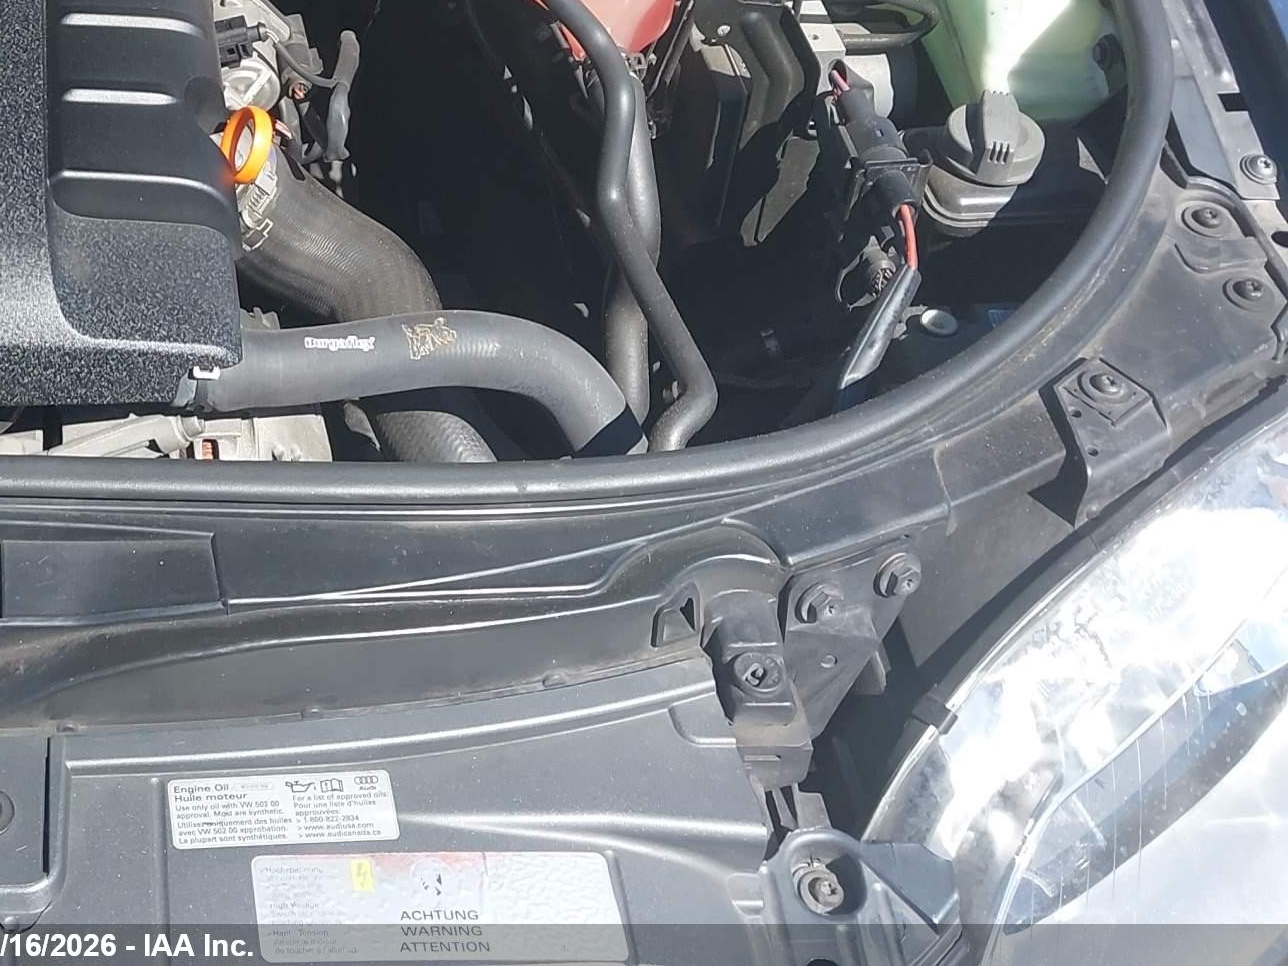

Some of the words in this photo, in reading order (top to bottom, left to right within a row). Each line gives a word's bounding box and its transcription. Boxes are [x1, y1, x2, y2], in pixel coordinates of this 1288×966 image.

[173, 785, 211, 795] Engine
[214, 784, 229, 792] Oil
[174, 794, 202, 802] Huile
[206, 793, 248, 801] moteur
[192, 804, 208, 812] only
[222, 802, 238, 810] with
[198, 828, 211, 836] VW
[400, 909, 480, 921] ACHTUNG
[400, 925, 483, 936] WARNING
[400, 941, 491, 952] ATTENTION
